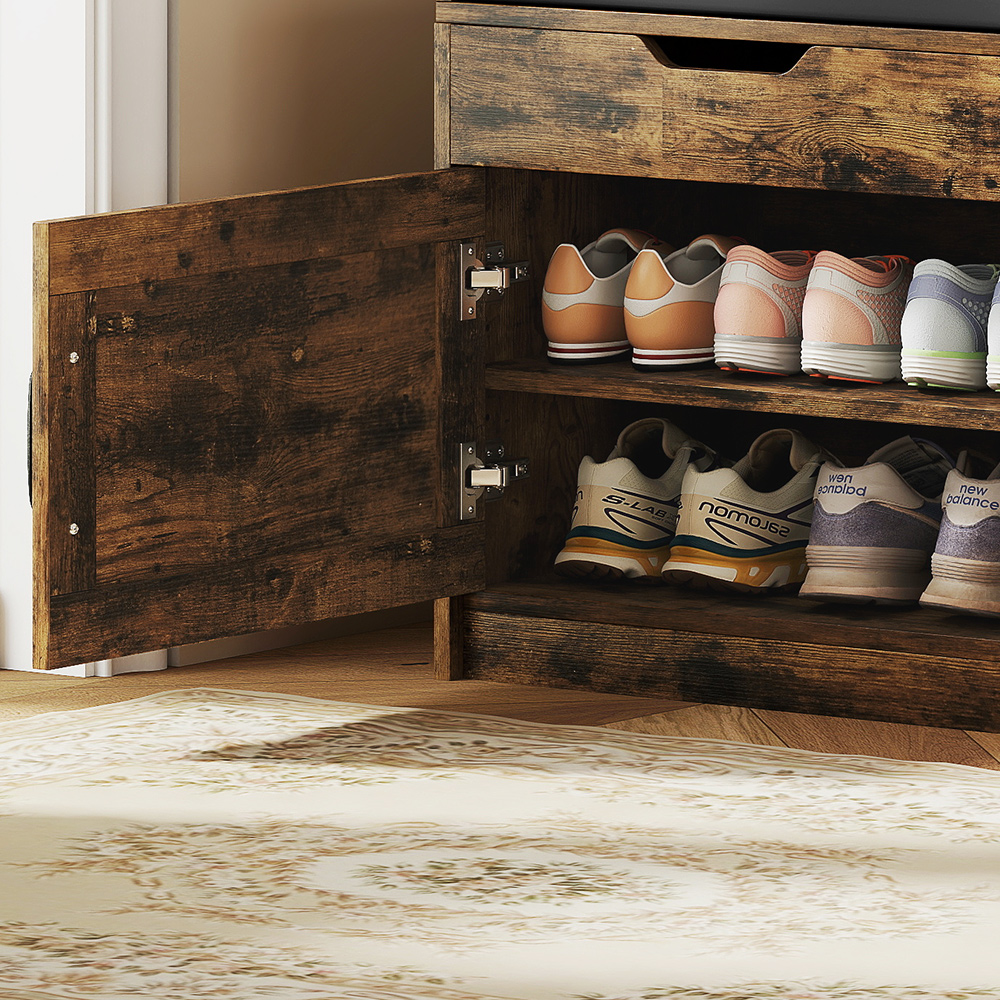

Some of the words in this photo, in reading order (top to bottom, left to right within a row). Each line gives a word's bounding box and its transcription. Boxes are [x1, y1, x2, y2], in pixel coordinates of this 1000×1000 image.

[959, 484, 988, 497] new
[601, 494, 668, 518] S-LAB
[946, 493, 1000, 511] balance
